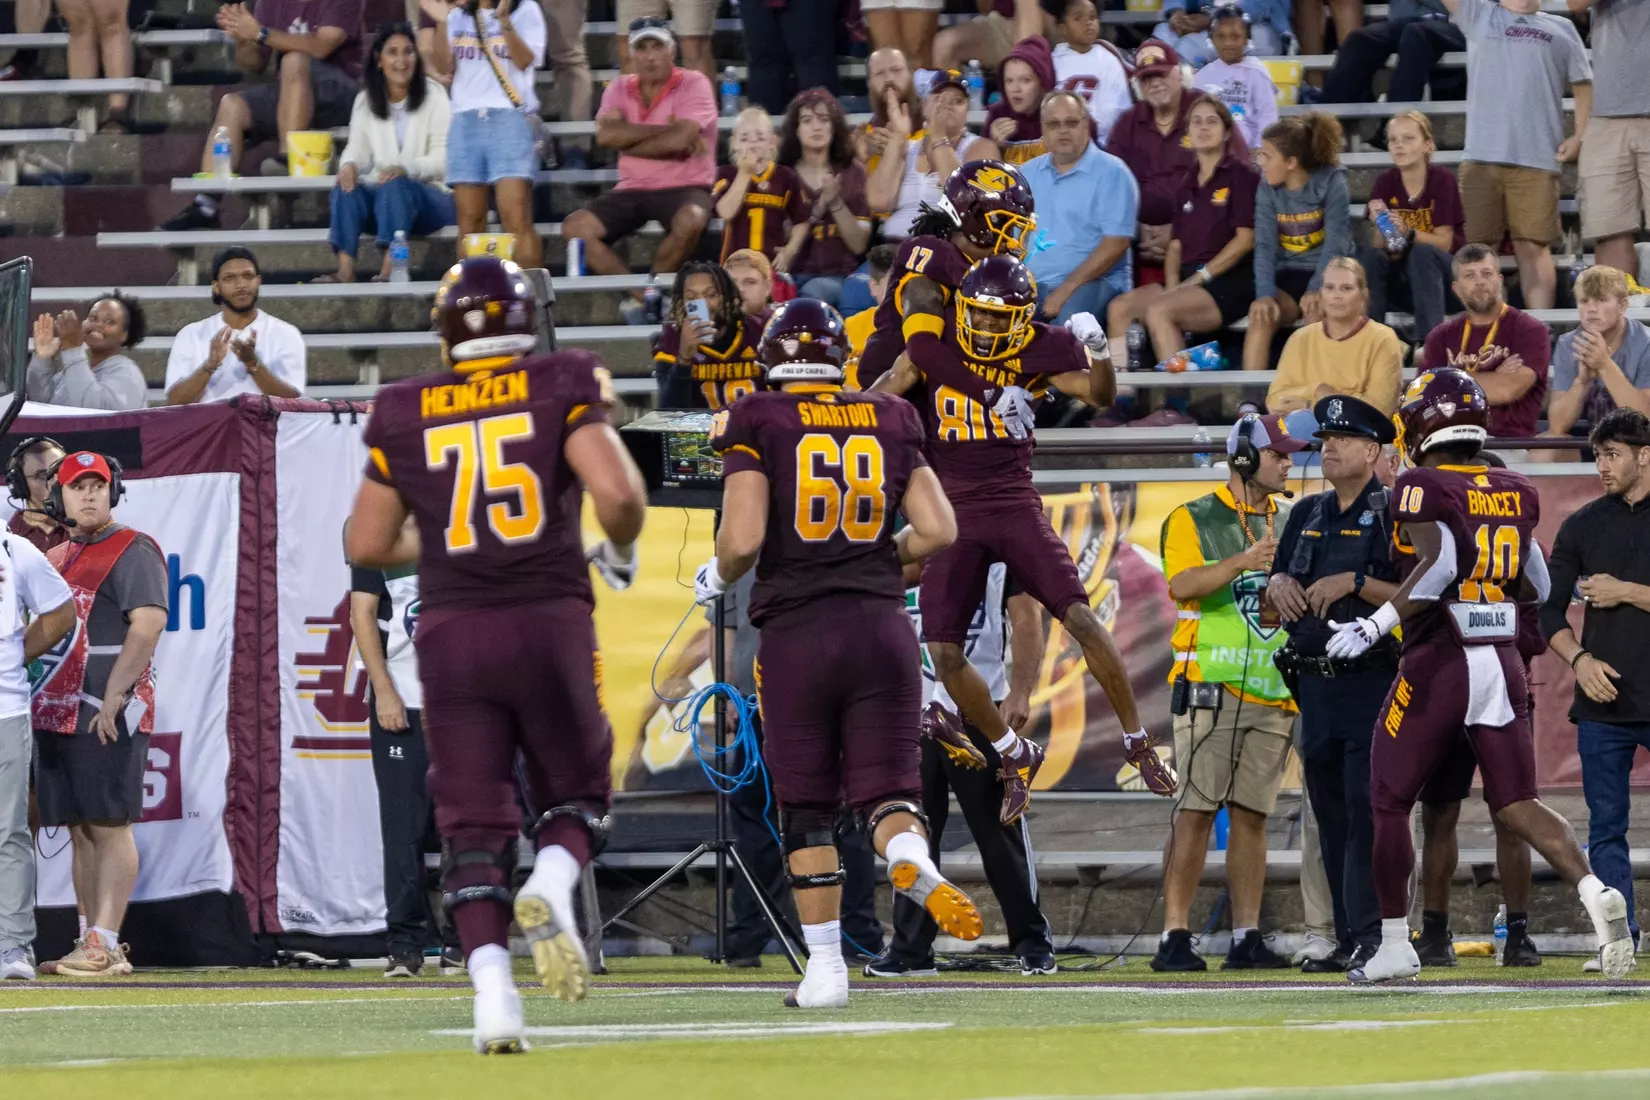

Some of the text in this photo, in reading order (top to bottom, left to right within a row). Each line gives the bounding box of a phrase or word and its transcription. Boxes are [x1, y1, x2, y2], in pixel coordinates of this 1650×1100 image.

[1504, 26, 1553, 43] CHIPPEWA
[906, 245, 933, 274] 17
[421, 371, 528, 417] HEINZEN
[798, 401, 878, 428] SWARTOUT
[424, 411, 545, 555] 75
[794, 433, 885, 542] 68
[1398, 485, 1425, 514] 10
[1467, 489, 1522, 517] BRACEY
[1459, 523, 1521, 603] 10
[1468, 611, 1506, 628] DOUGLAS
[1384, 675, 1413, 738] FIRE UP!
